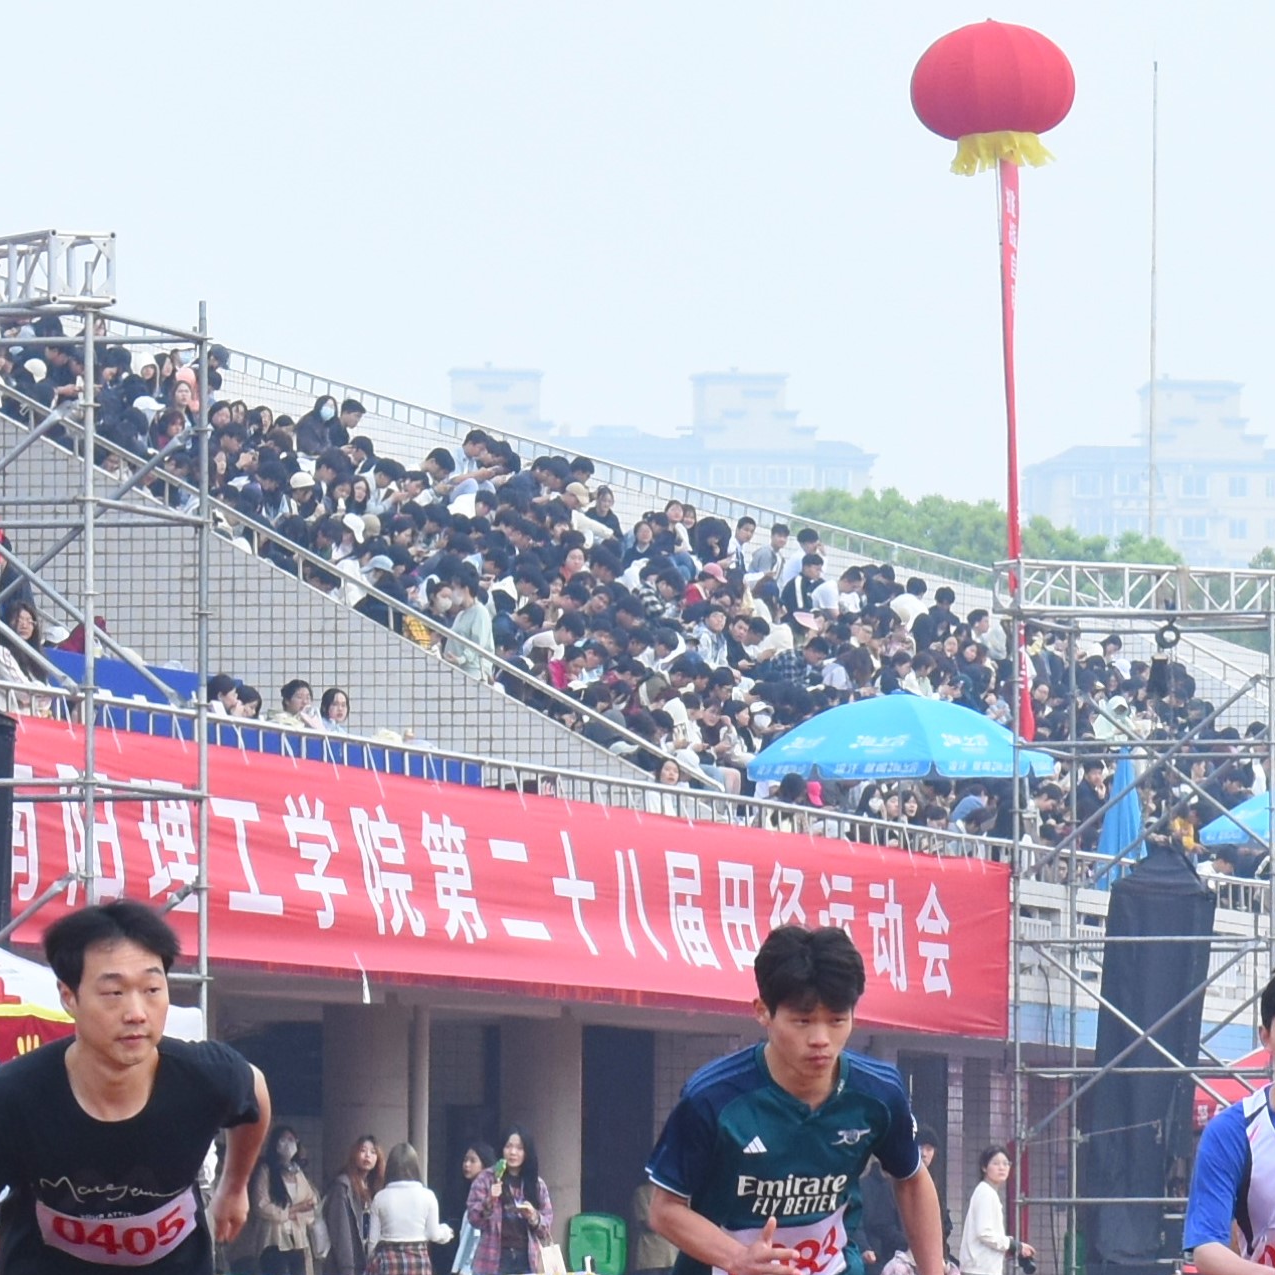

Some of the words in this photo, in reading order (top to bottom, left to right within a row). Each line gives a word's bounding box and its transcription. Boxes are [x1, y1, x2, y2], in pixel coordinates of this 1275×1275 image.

[751, 1196, 782, 1216] FLY
[782, 1193, 838, 1216] BETTER
[52, 1205, 186, 1256] 0405
